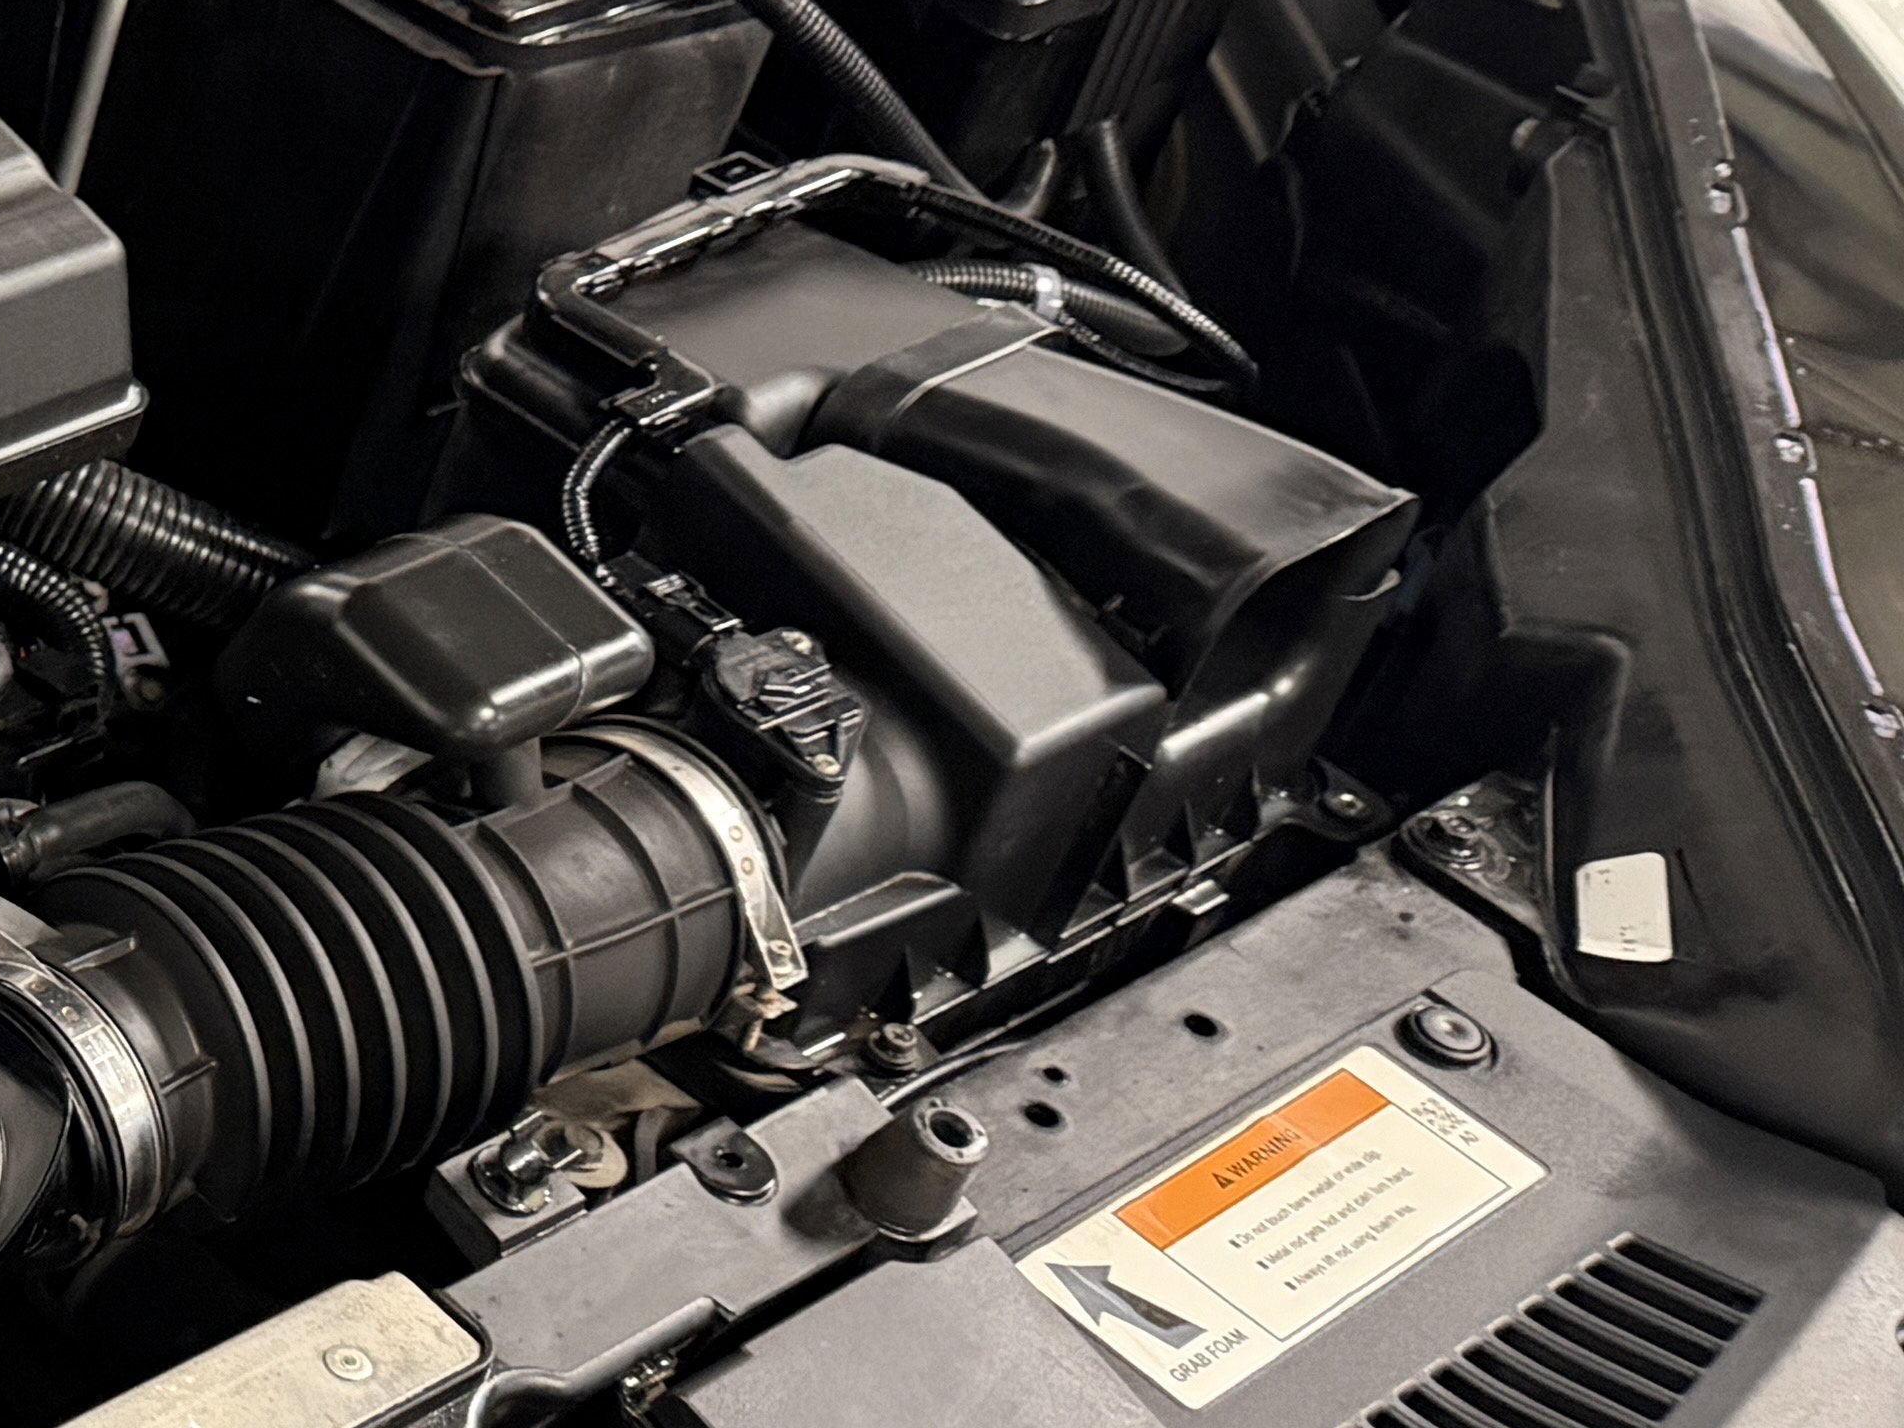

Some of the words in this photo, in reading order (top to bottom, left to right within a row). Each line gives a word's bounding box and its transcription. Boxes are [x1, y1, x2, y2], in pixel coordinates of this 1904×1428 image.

[1226, 1128, 1302, 1178] WARNING
[1169, 1352, 1212, 1382] GRAB
[1204, 1328, 1250, 1360] FOAM
